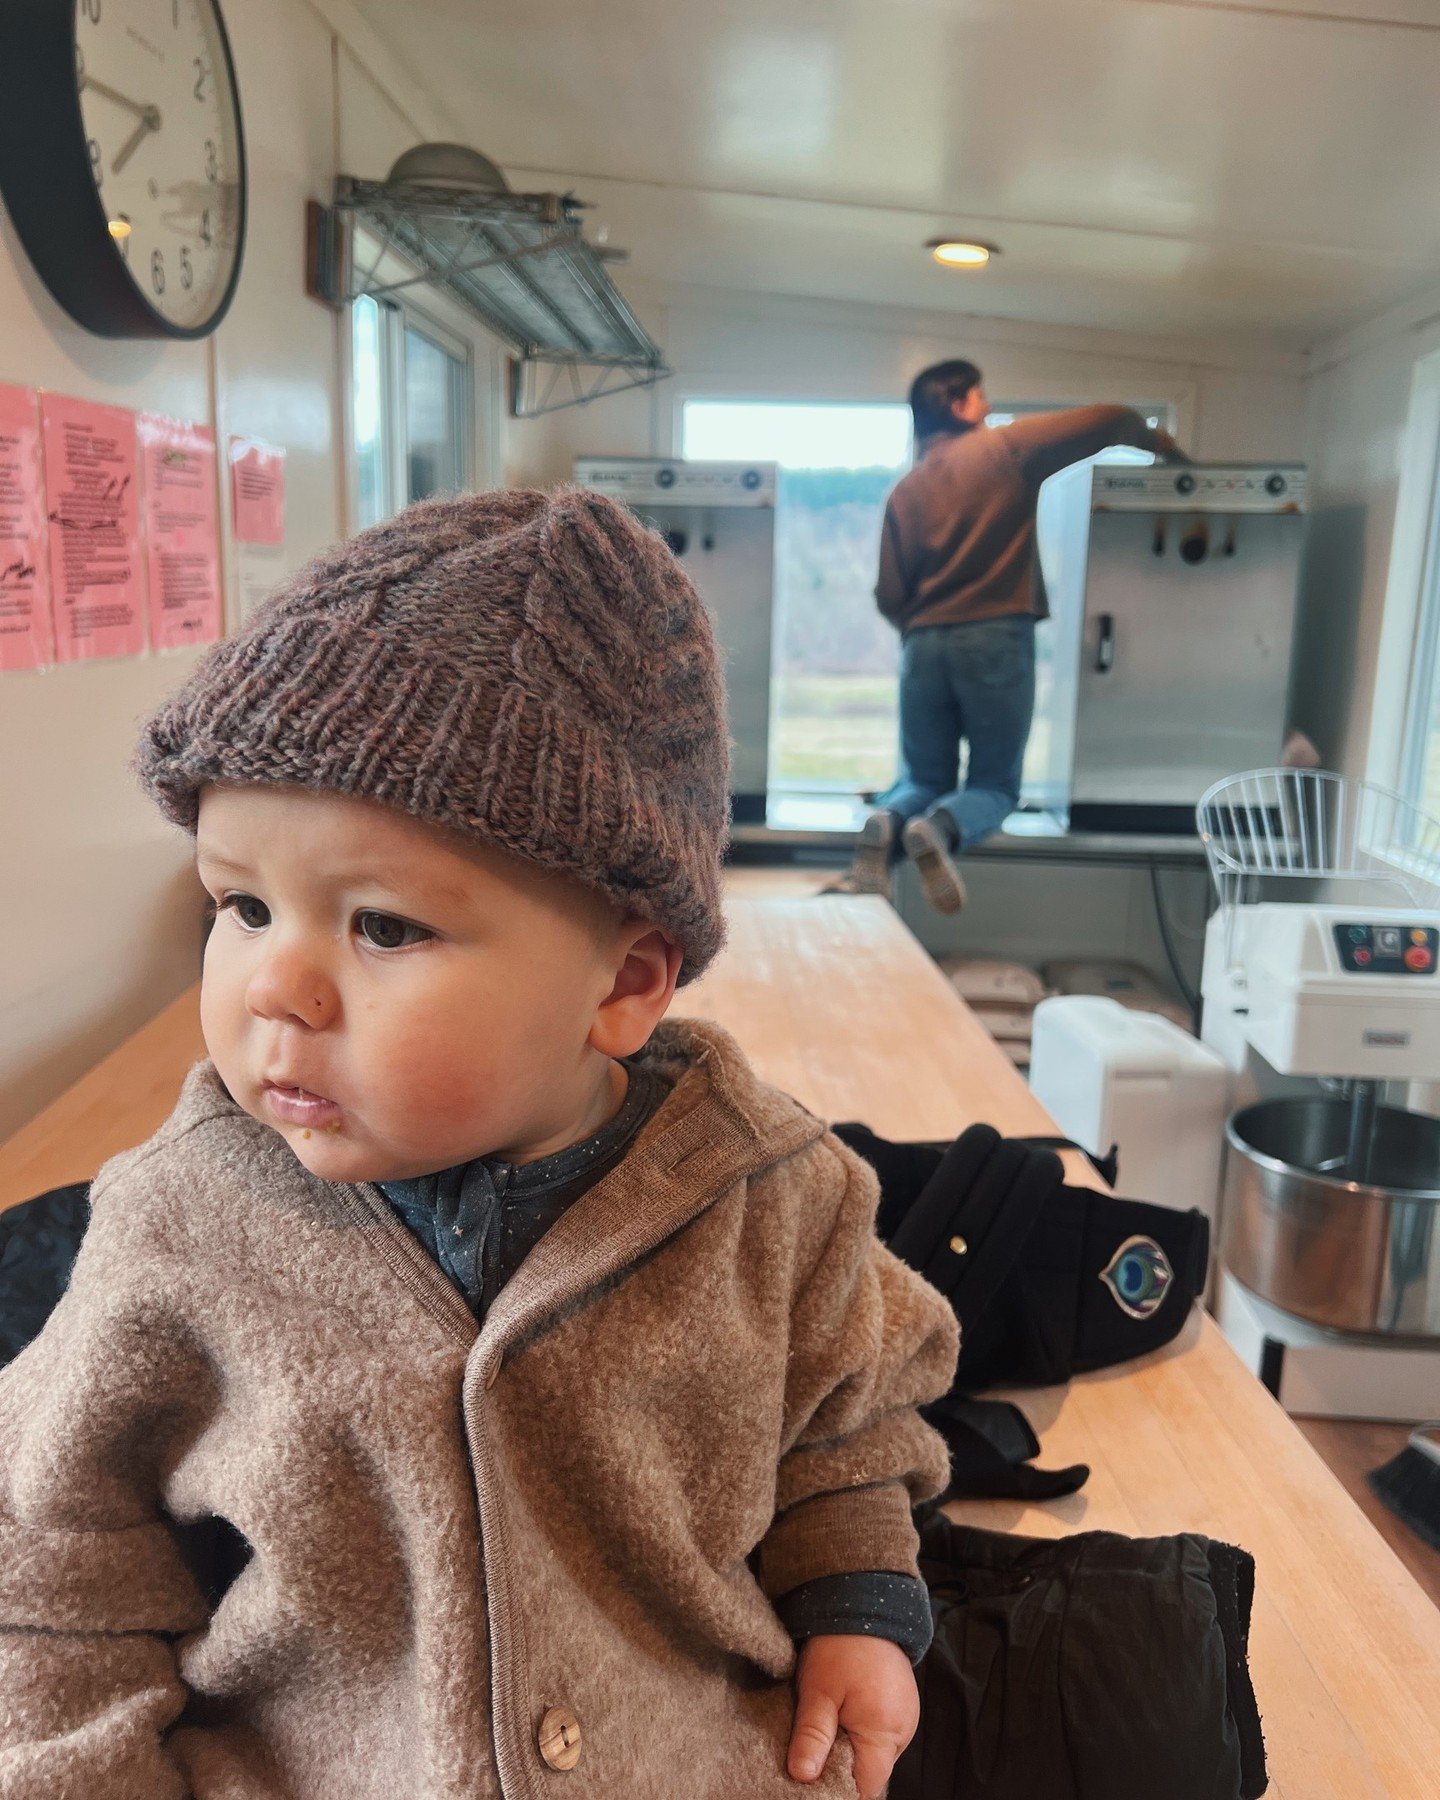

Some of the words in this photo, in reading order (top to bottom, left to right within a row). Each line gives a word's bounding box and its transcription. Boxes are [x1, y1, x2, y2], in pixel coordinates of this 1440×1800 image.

[193, 57, 207, 103] 2
[204, 138, 217, 183] 3
[150, 247, 166, 296] 6
[179, 245, 194, 291] 5
